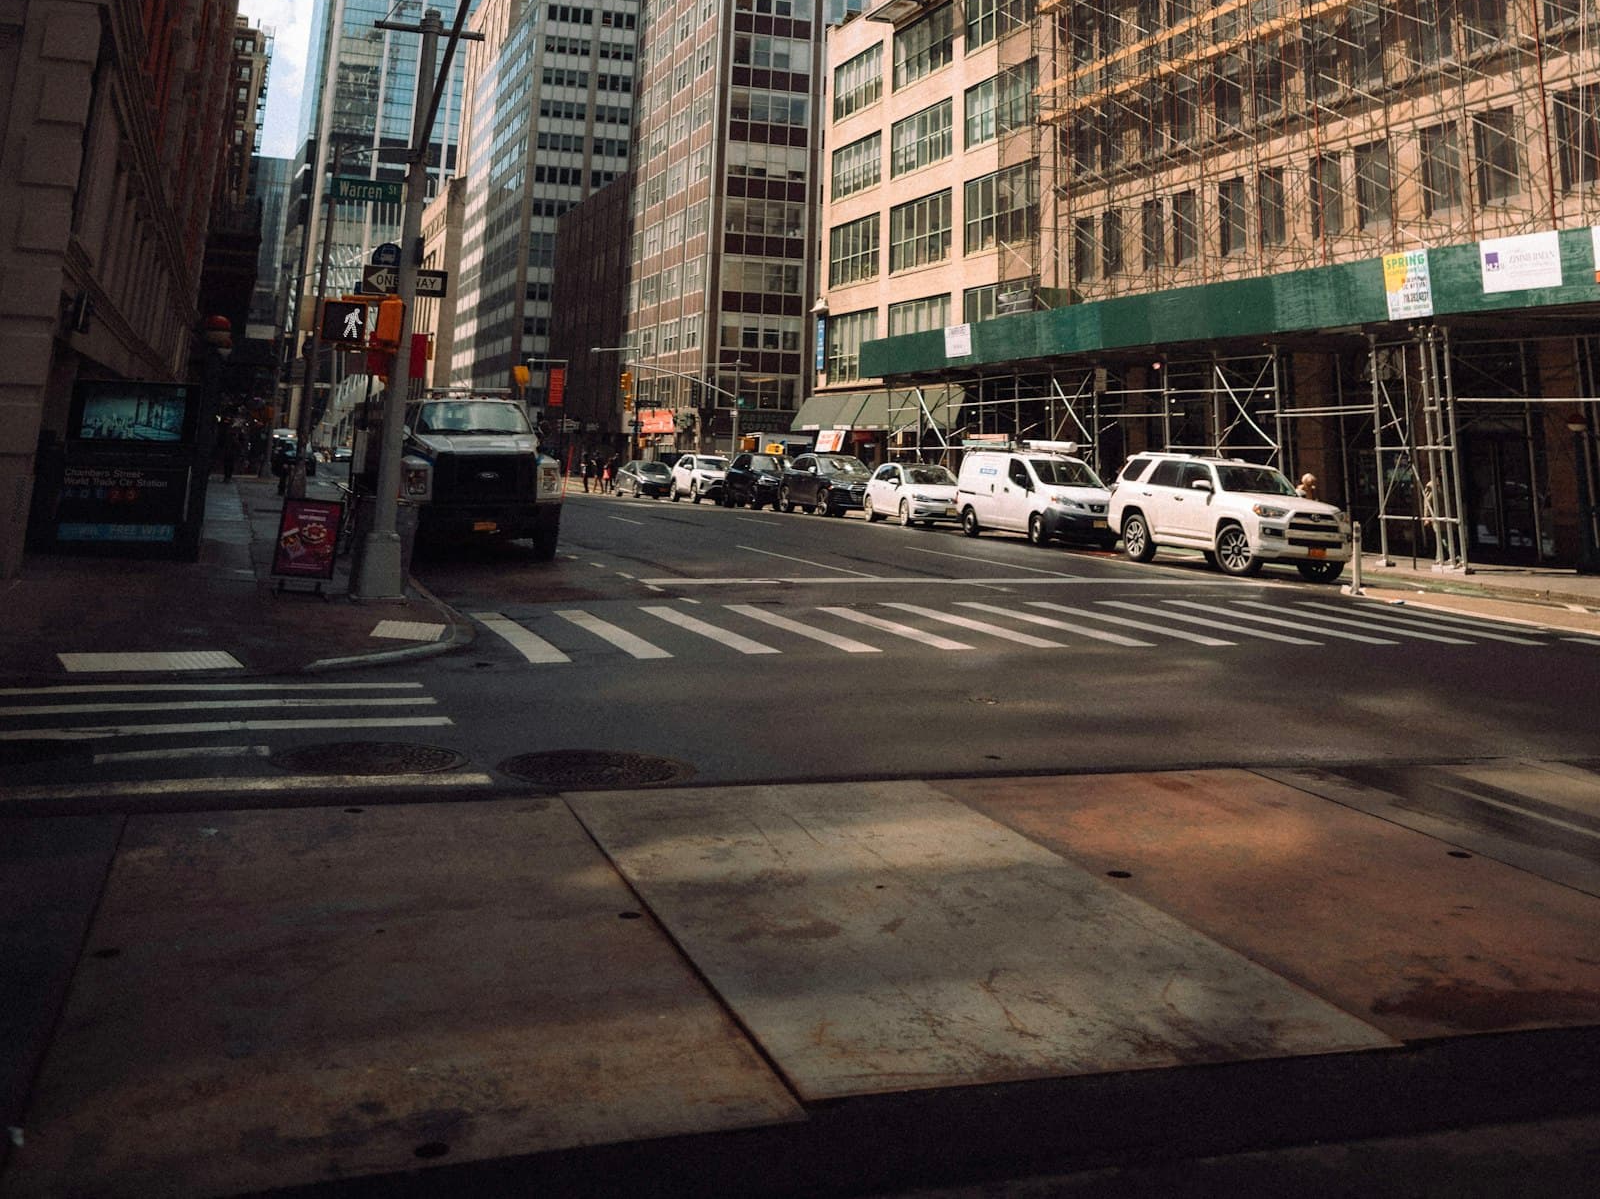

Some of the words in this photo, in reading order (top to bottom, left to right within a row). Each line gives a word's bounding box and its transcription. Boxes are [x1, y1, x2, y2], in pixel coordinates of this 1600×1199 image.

[340, 181, 383, 200] Warren
[388, 184, 397, 195] St
[1386, 253, 1425, 269] SPRING
[376, 273, 399, 286] ONE
[65, 469, 111, 478] Chambers
[64, 477, 90, 486] World
[136, 479, 168, 488] Station
